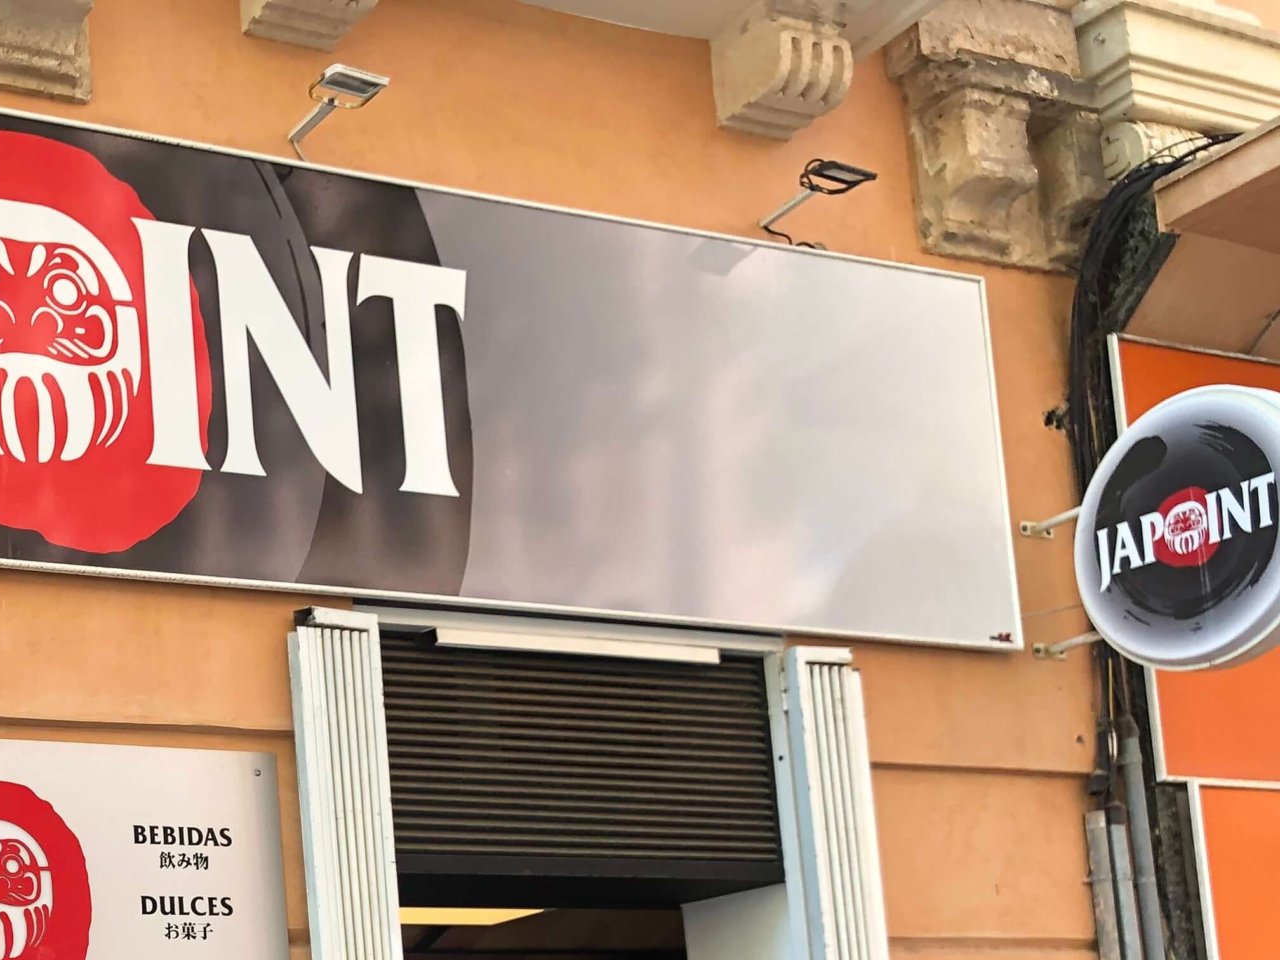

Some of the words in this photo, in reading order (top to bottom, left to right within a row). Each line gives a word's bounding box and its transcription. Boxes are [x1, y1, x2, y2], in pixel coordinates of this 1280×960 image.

[1096, 472, 1275, 592] JAPOINT
[133, 825, 232, 847] BEBIDAS
[160, 852, 208, 870] 飲み物
[141, 896, 233, 916] DULCES
[165, 922, 213, 940] お菓子
